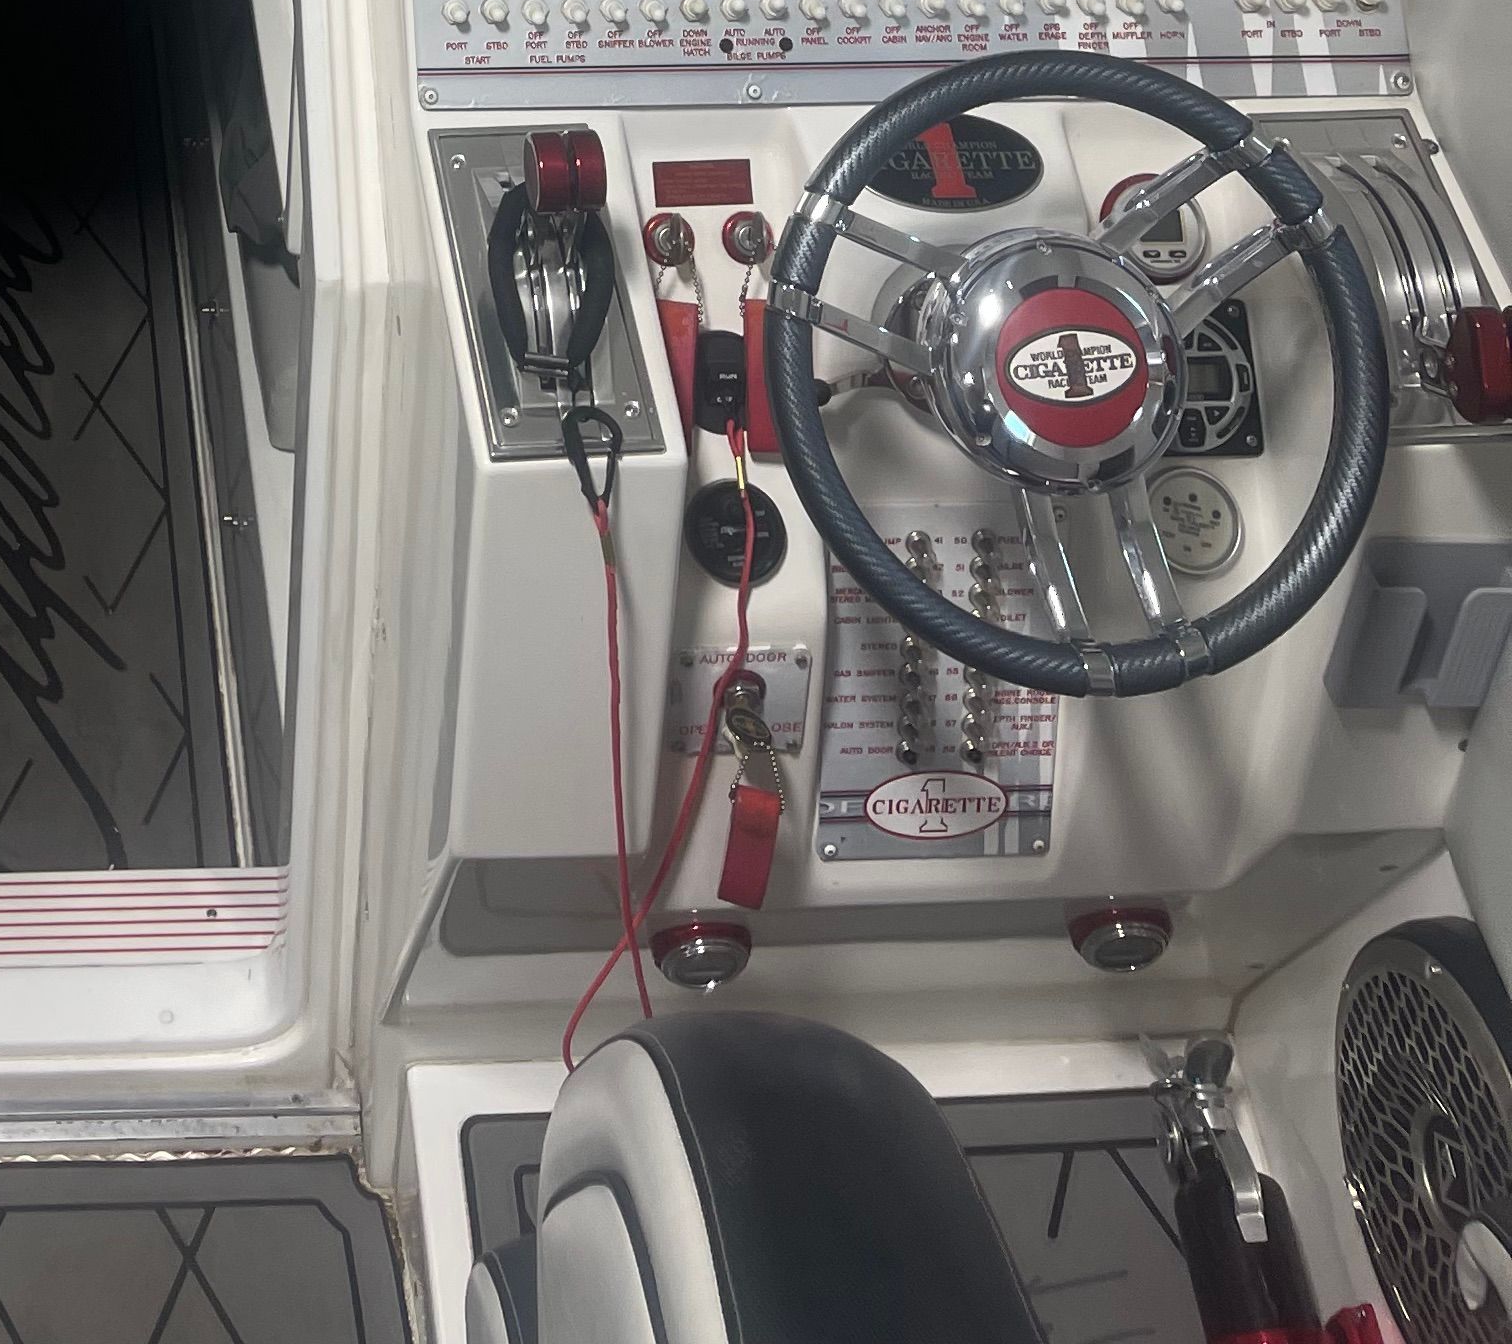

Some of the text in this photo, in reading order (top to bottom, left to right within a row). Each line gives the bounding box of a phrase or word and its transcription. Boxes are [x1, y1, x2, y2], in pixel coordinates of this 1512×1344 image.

[806, 27, 822, 35] OFF
[885, 26, 901, 34] OFF
[915, 25, 950, 33] ANCHOR
[1320, 29, 1341, 37] PORT
[568, 31, 584, 39] OFF
[607, 30, 623, 38] OFF
[957, 33, 990, 42] ENGINE
[998, 33, 1028, 41] WATER
[1039, 32, 1067, 40] ERASE
[1241, 30, 1263, 38] PORT
[598, 40, 634, 48] SNIFFER
[638, 39, 673, 47] BLOWER
[680, 39, 711, 47] ENGINE
[736, 38, 775, 46] RUNNING
[837, 36, 871, 44] COCKPIT
[882, 36, 906, 44] CABIN
[446, 42, 468, 50] PORT
[486, 42, 508, 50] STBD
[525, 41, 547, 49] PORT
[683, 48, 711, 56] HATCH
[757, 52, 786, 60] PUMPS
[465, 57, 491, 65] START
[556, 55, 585, 63] PUMPS
[1030, 350, 1064, 361] WORLD
[1013, 353, 1133, 380] CIGAETTE
[746, 653, 786, 662] DOOR
[872, 797, 1001, 815] CIGARETTE
